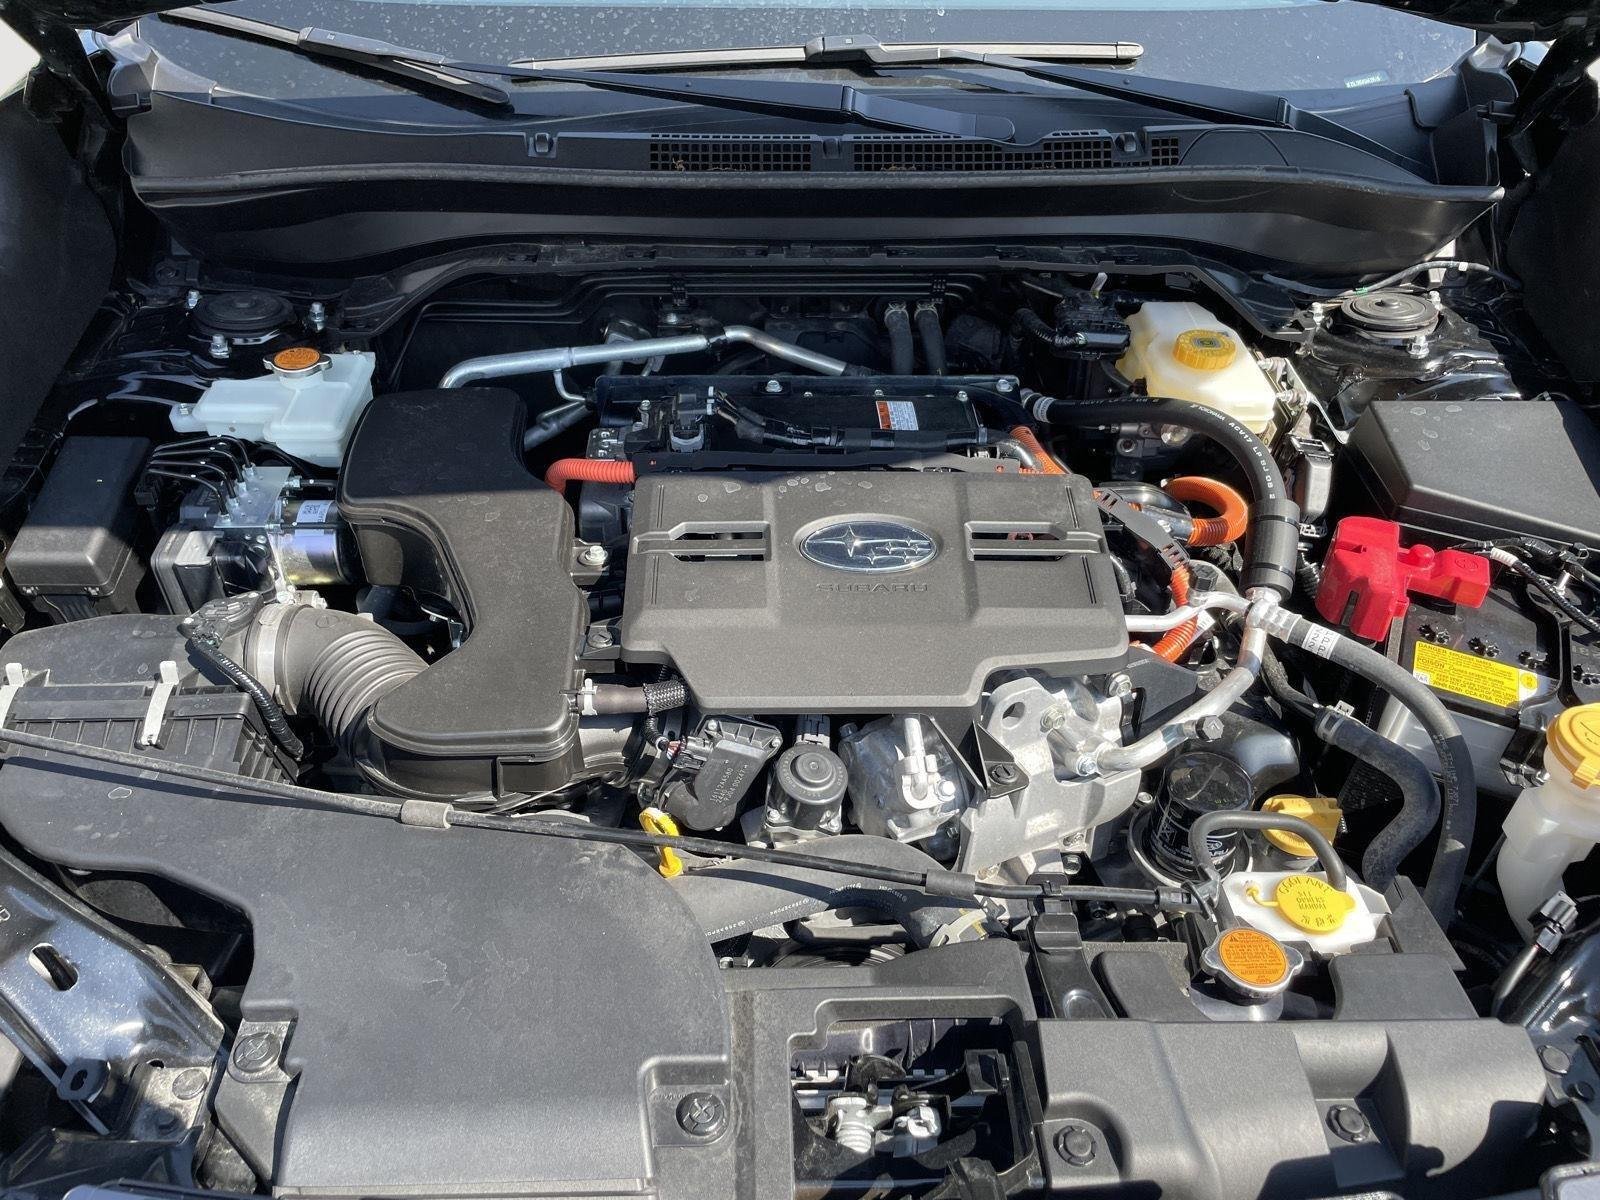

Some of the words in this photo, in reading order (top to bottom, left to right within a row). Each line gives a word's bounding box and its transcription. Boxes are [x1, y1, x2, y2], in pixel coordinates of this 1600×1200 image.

[816, 583, 928, 593] SUBARU
[1418, 644, 1447, 653] DANGER
[1416, 658, 1444, 667] POISON
